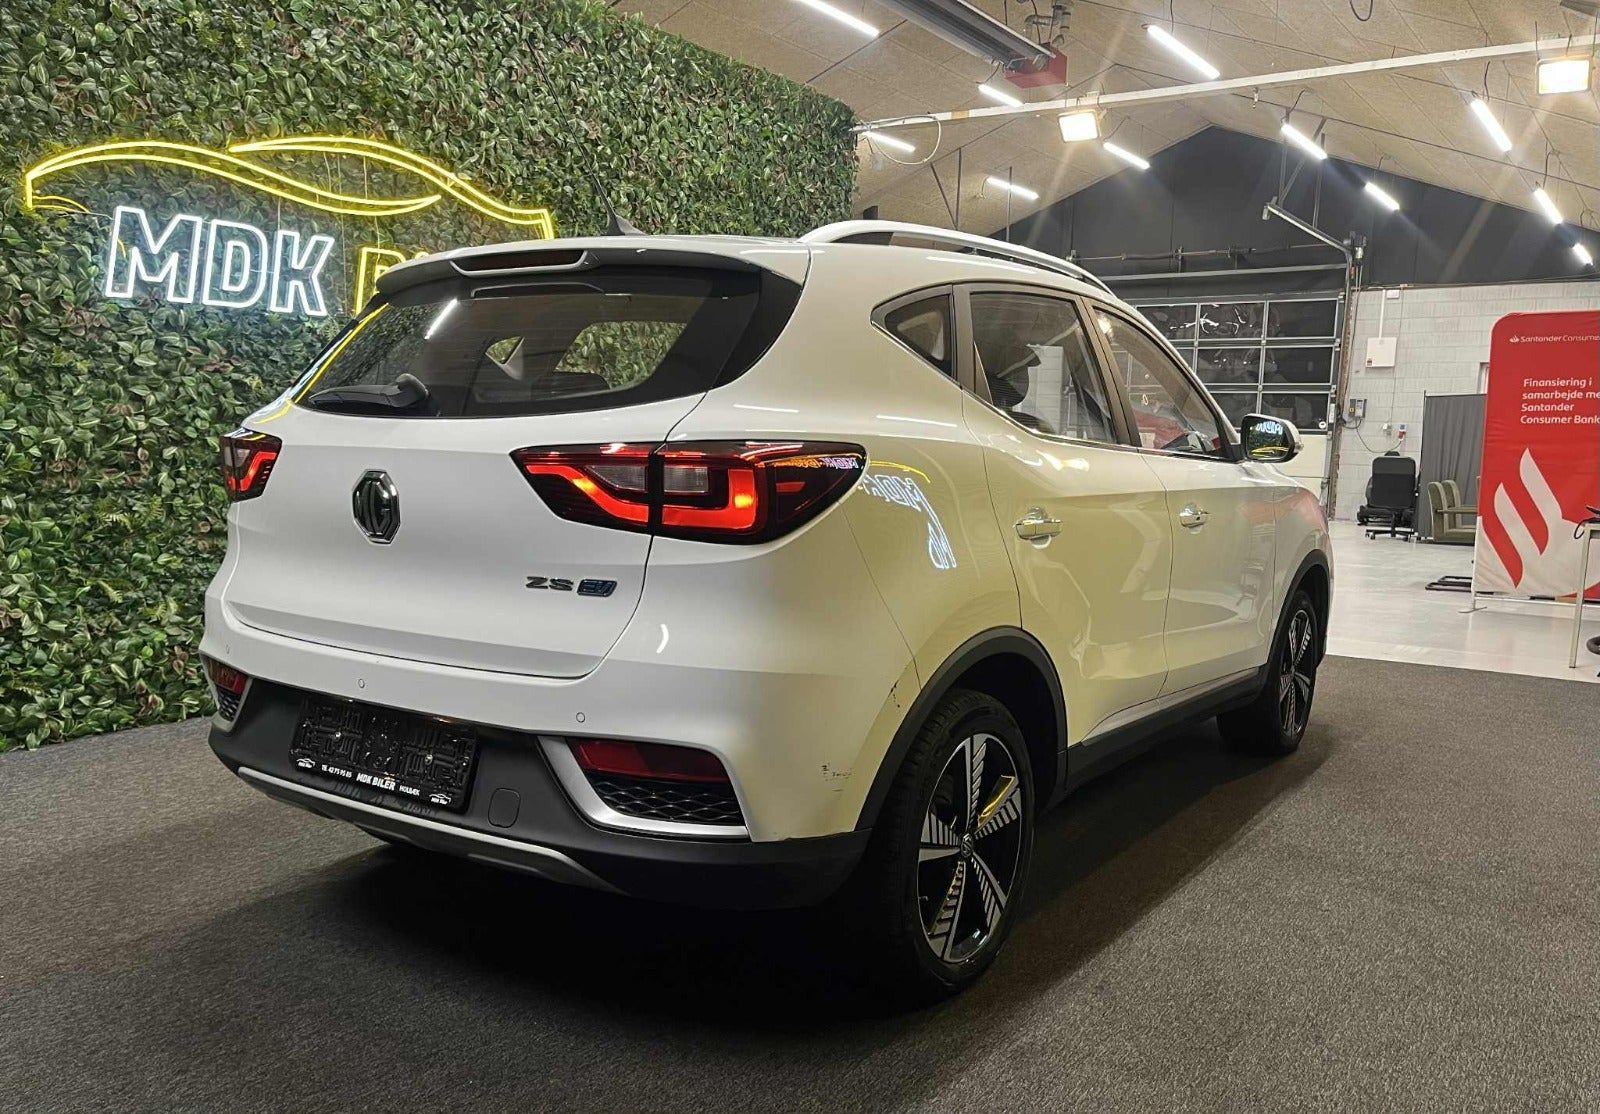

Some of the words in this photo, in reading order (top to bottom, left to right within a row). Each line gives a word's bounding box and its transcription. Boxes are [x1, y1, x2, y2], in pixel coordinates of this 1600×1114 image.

[105, 205, 335, 316] MDK
[1523, 377, 1586, 389] Finansiering
[1588, 376, 1593, 386] i
[1522, 389, 1584, 400] samarbejde
[1521, 402, 1574, 412] Santander
[1520, 415, 1572, 424] Consumer
[1573, 414, 1600, 424] Bank
[525, 576, 574, 591] ZS
[356, 772, 373, 785] MDK
[371, 776, 396, 791] BILER
